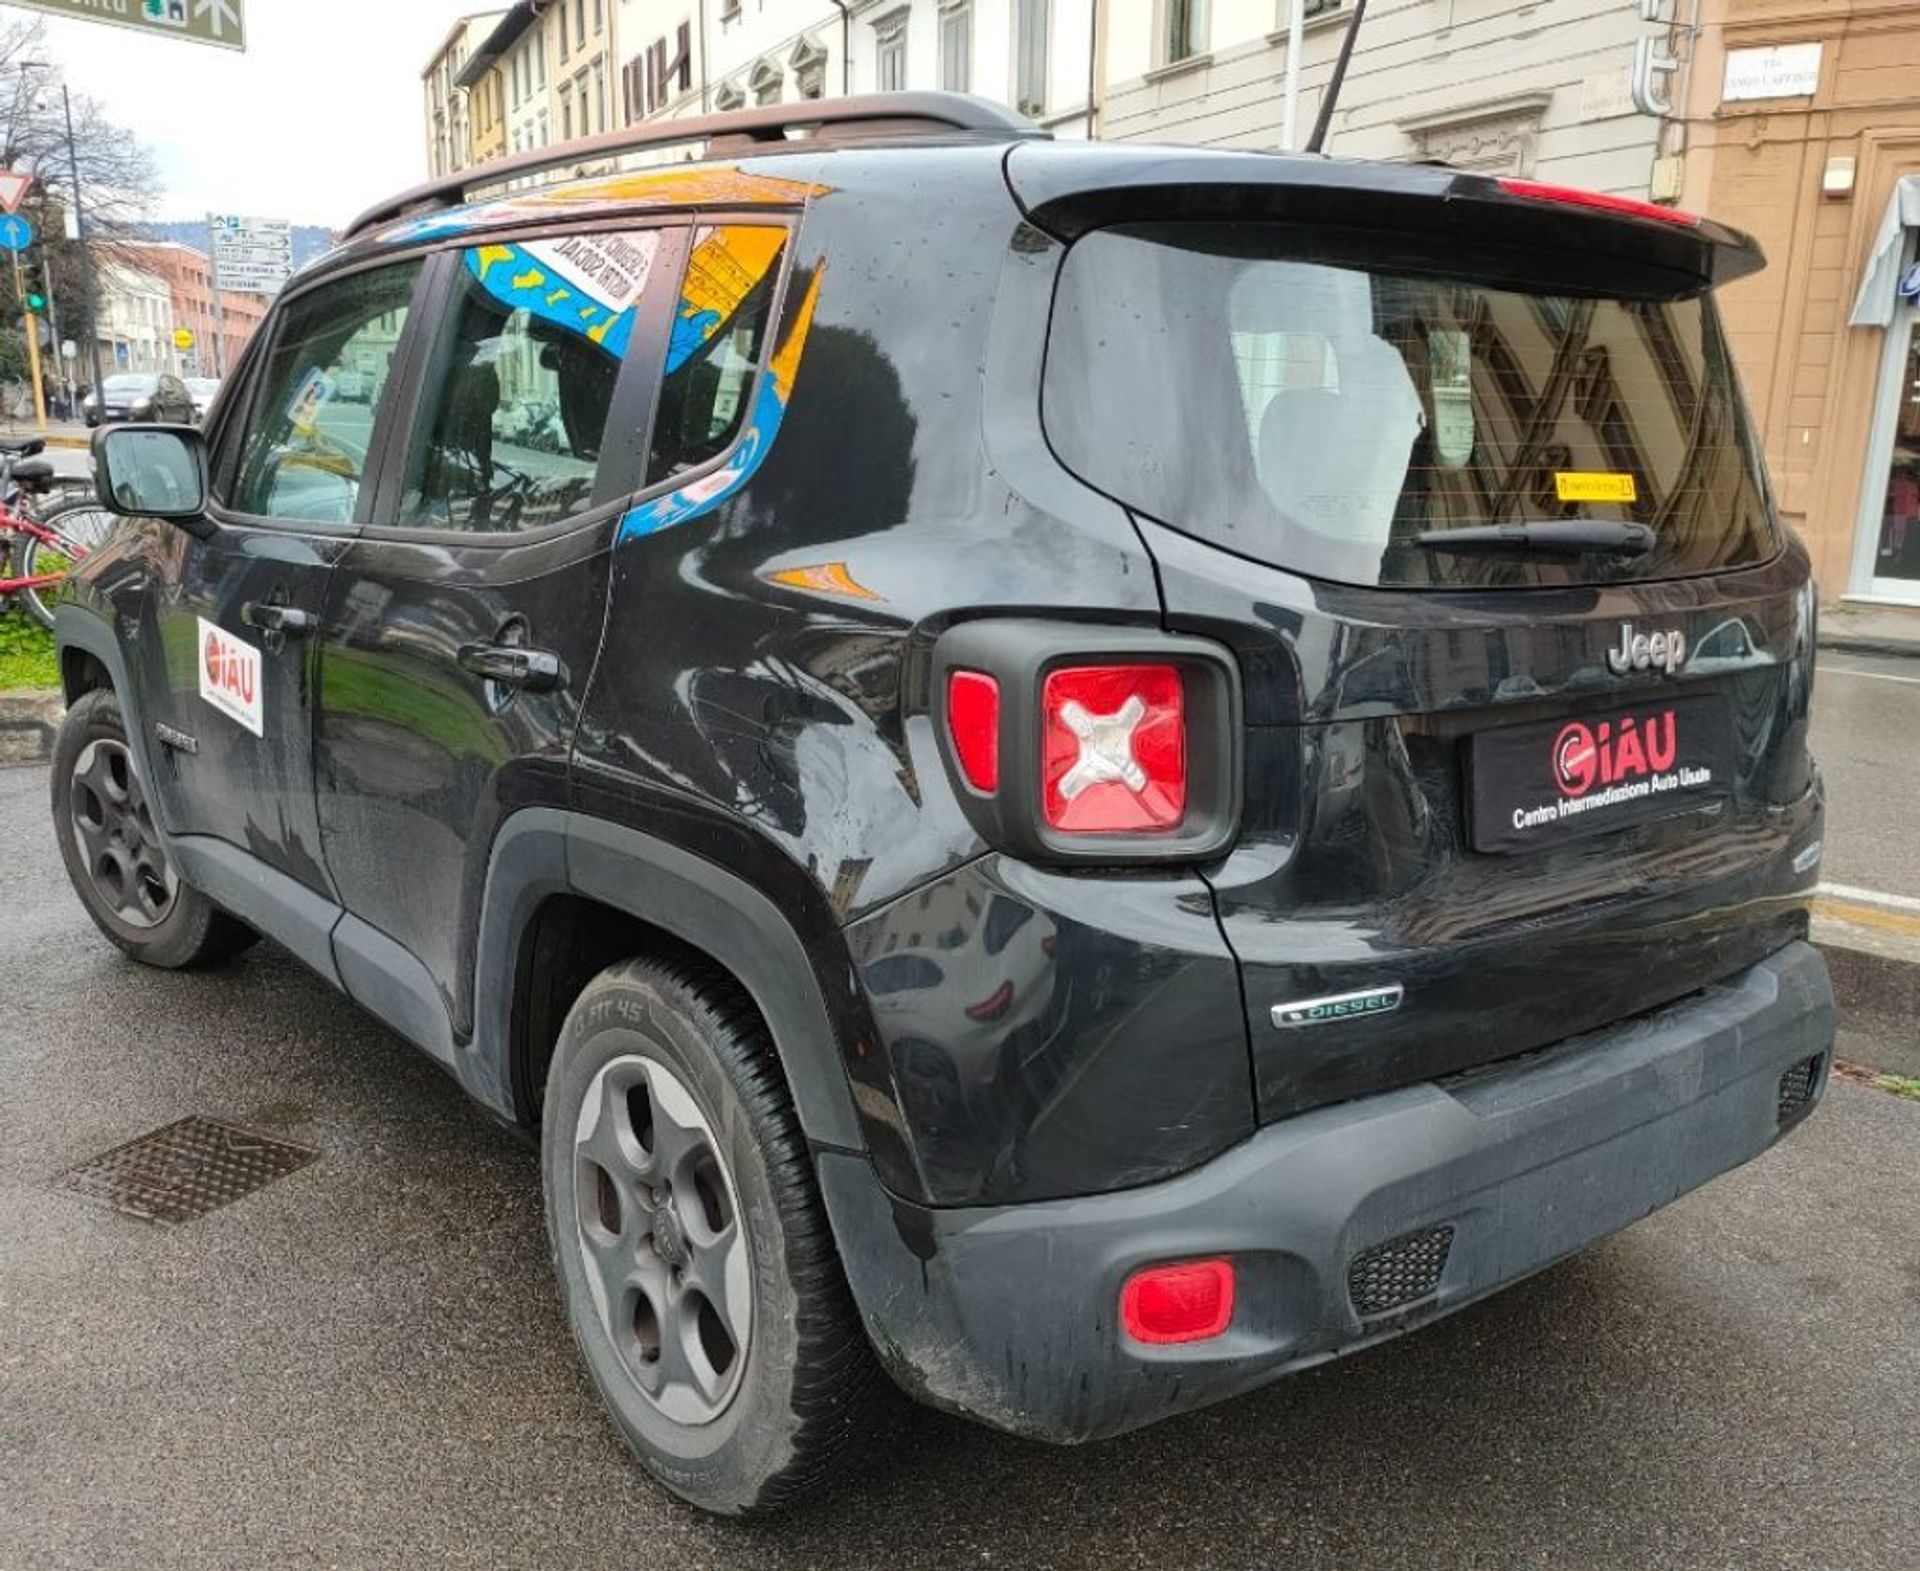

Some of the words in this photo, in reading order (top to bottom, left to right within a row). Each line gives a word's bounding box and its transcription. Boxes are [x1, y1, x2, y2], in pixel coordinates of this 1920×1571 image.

[1608, 624, 1686, 675] Jeep
[1512, 806, 1558, 830] Centro
[1558, 780, 1650, 817] Intermediazione
[1651, 773, 1678, 794] Auto
[1307, 994, 1394, 1019] DIESEL
